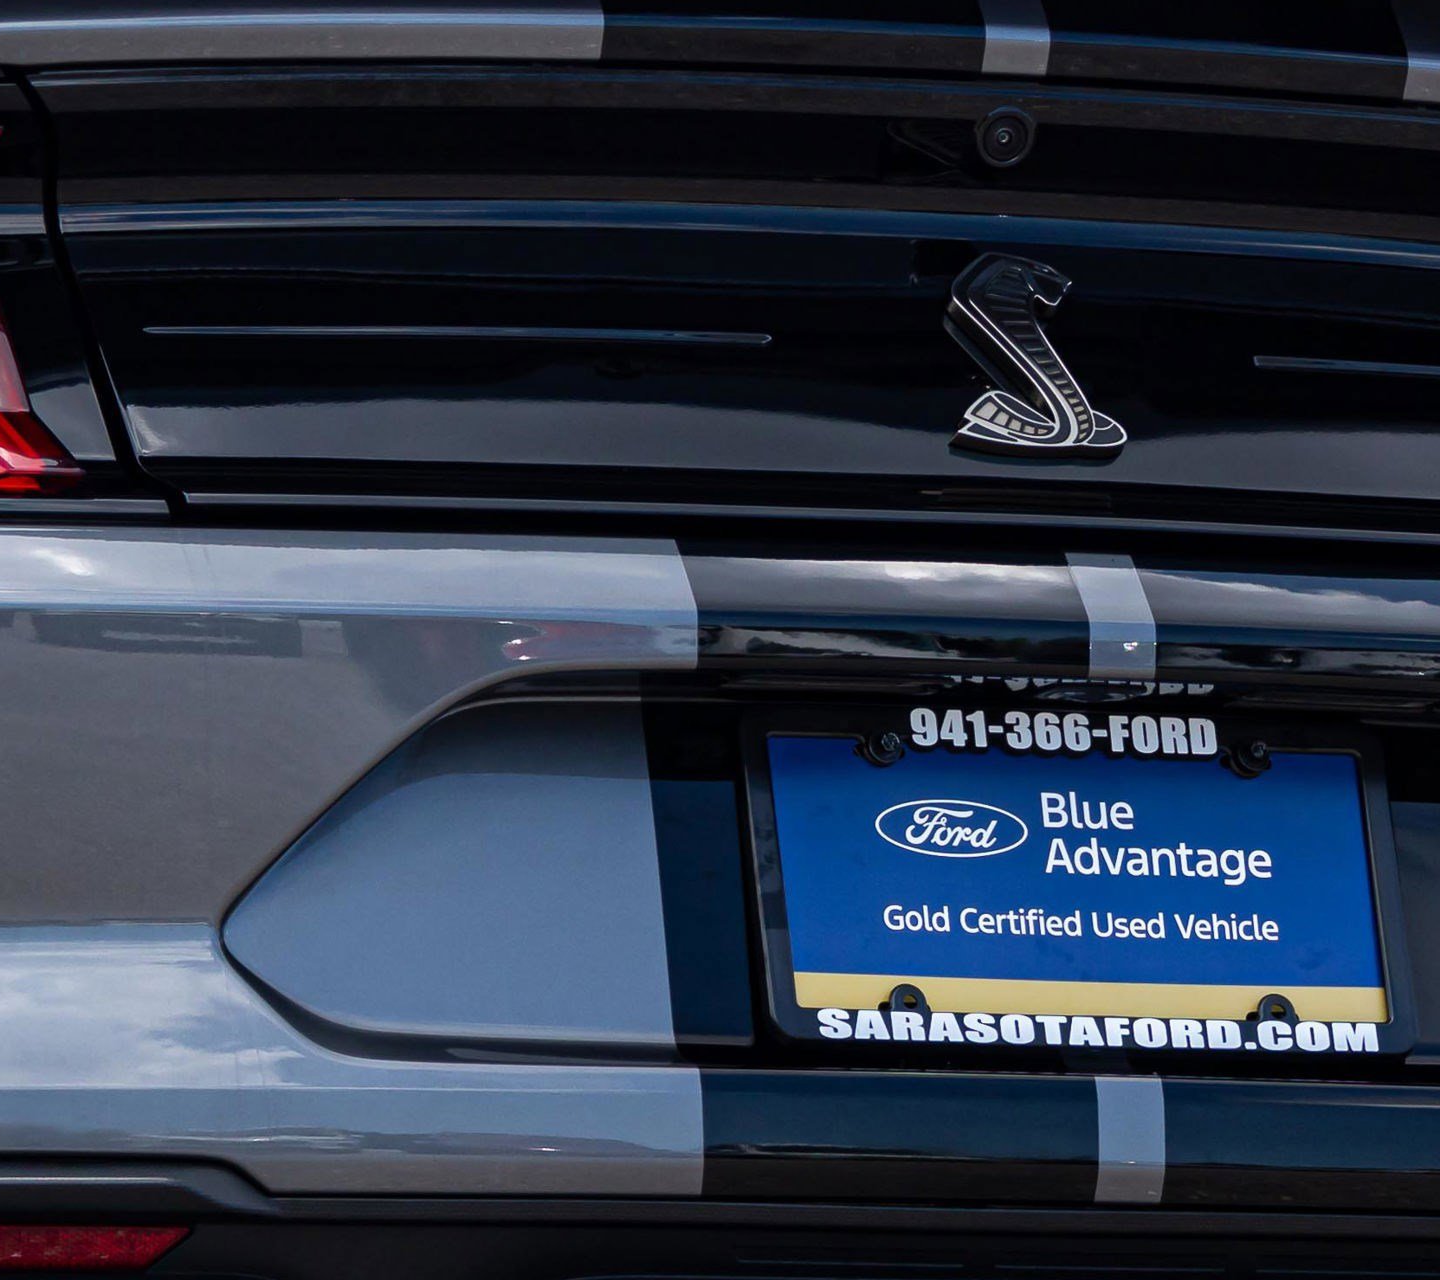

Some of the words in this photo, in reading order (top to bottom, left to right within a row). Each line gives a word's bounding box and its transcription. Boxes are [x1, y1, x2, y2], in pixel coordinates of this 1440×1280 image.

[909, 707, 1218, 756] 941-366-FORD
[905, 806, 998, 849] Ford
[1040, 791, 1134, 831] Blue
[1045, 838, 1273, 886] Advantage
[883, 904, 951, 933] Gold
[959, 907, 1082, 938] Certified
[1091, 911, 1166, 940] Used
[1174, 913, 1280, 942] Vehicle
[817, 1007, 1380, 1054] SARASOTAFORD.COM
